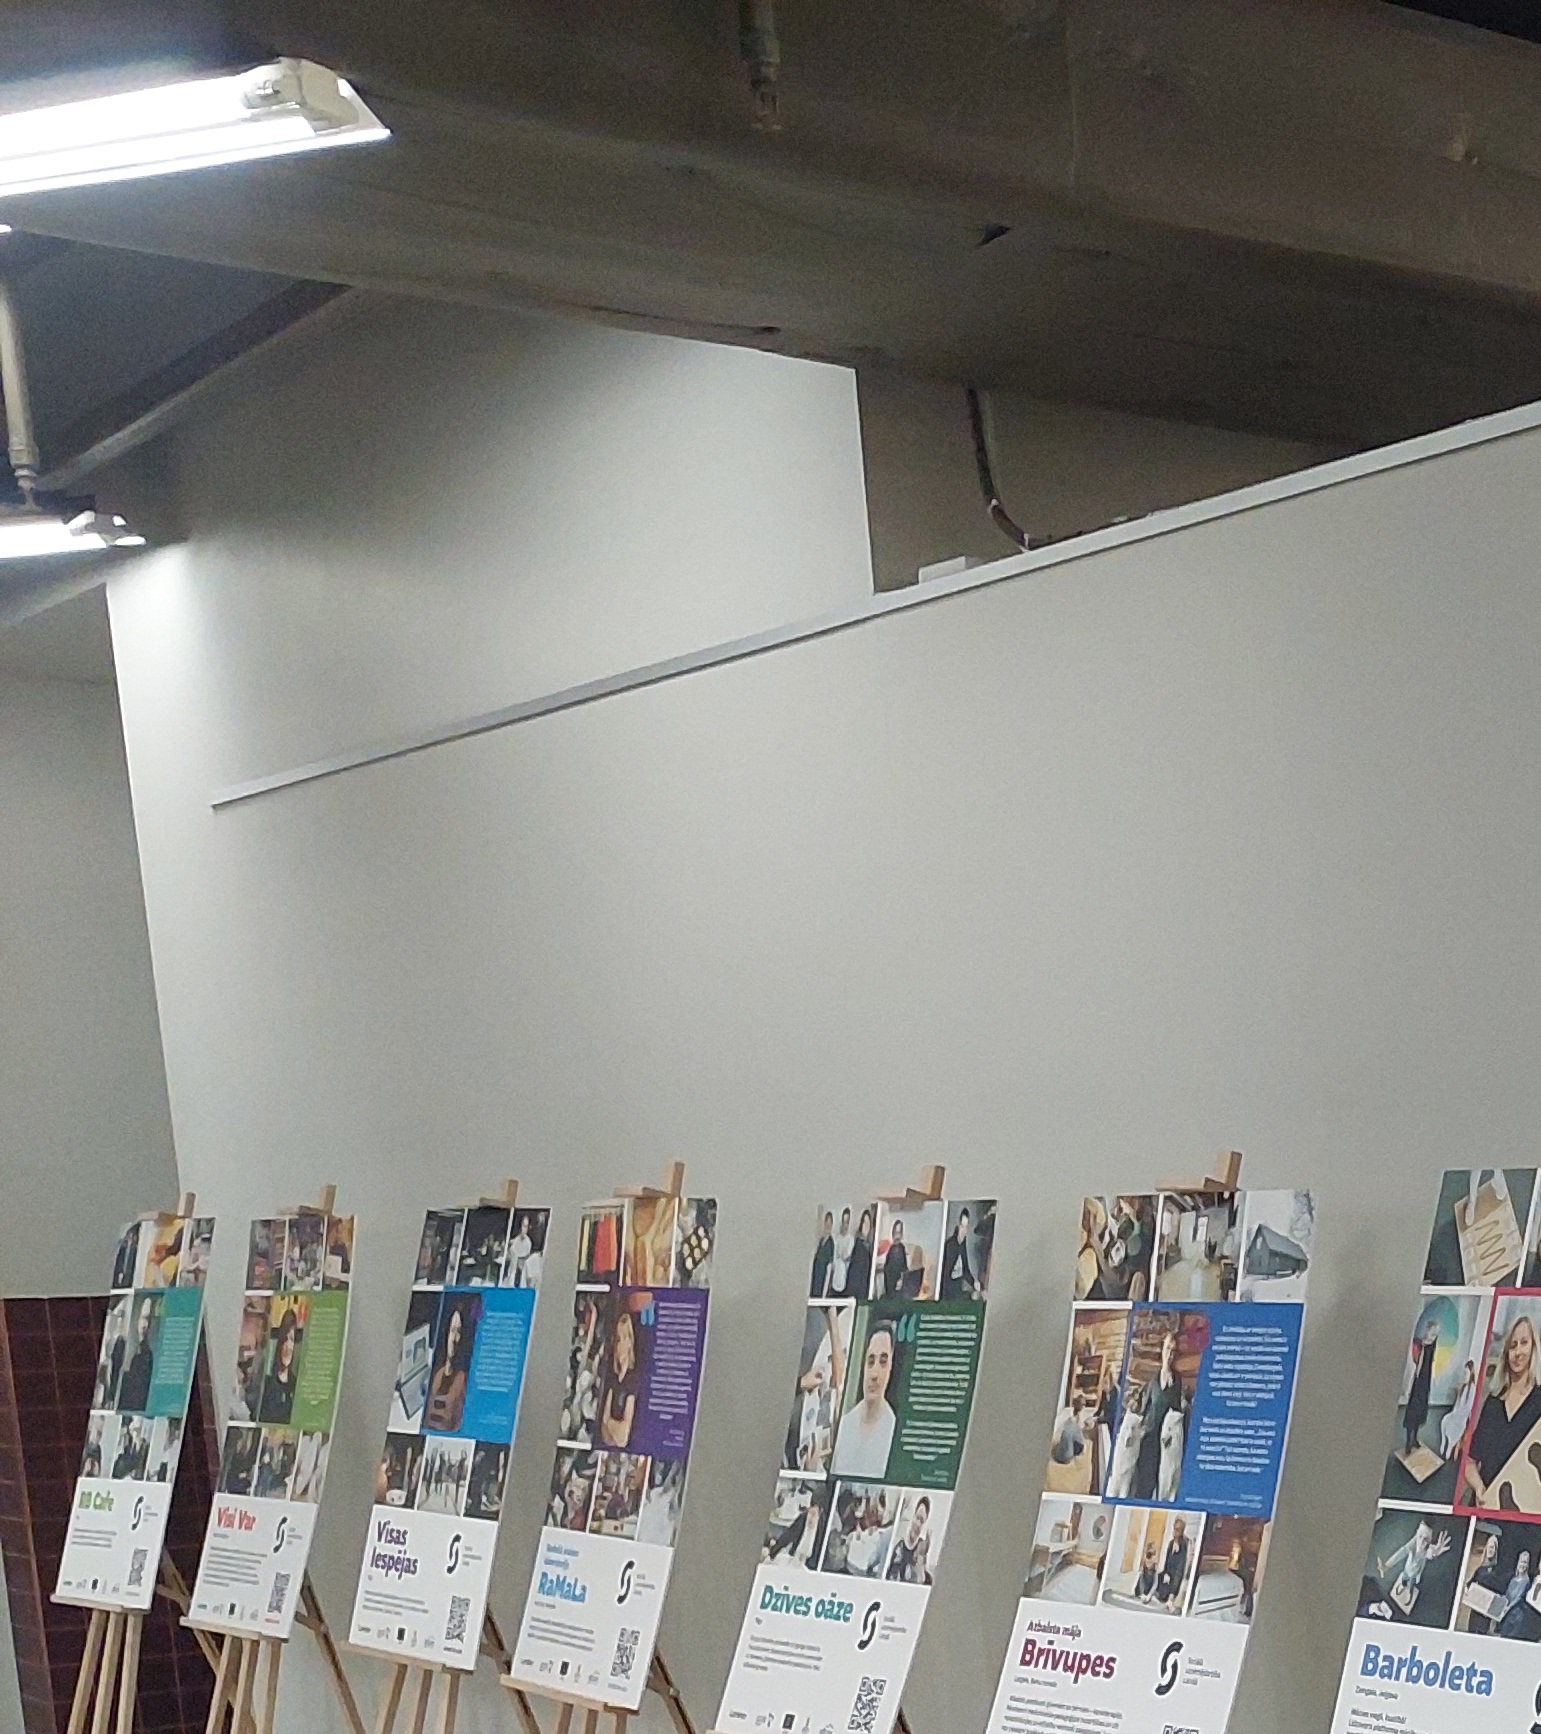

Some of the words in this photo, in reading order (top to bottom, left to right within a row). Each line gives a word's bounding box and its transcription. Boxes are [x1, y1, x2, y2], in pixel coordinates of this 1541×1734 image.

[377, 1520, 408, 1545] Visas
[371, 1546, 418, 1580] Iespējas
[760, 1585, 812, 1616] Dzīves
[1019, 1638, 1117, 1684] Brīvupes
[1360, 1644, 1493, 1696] Barboleta
